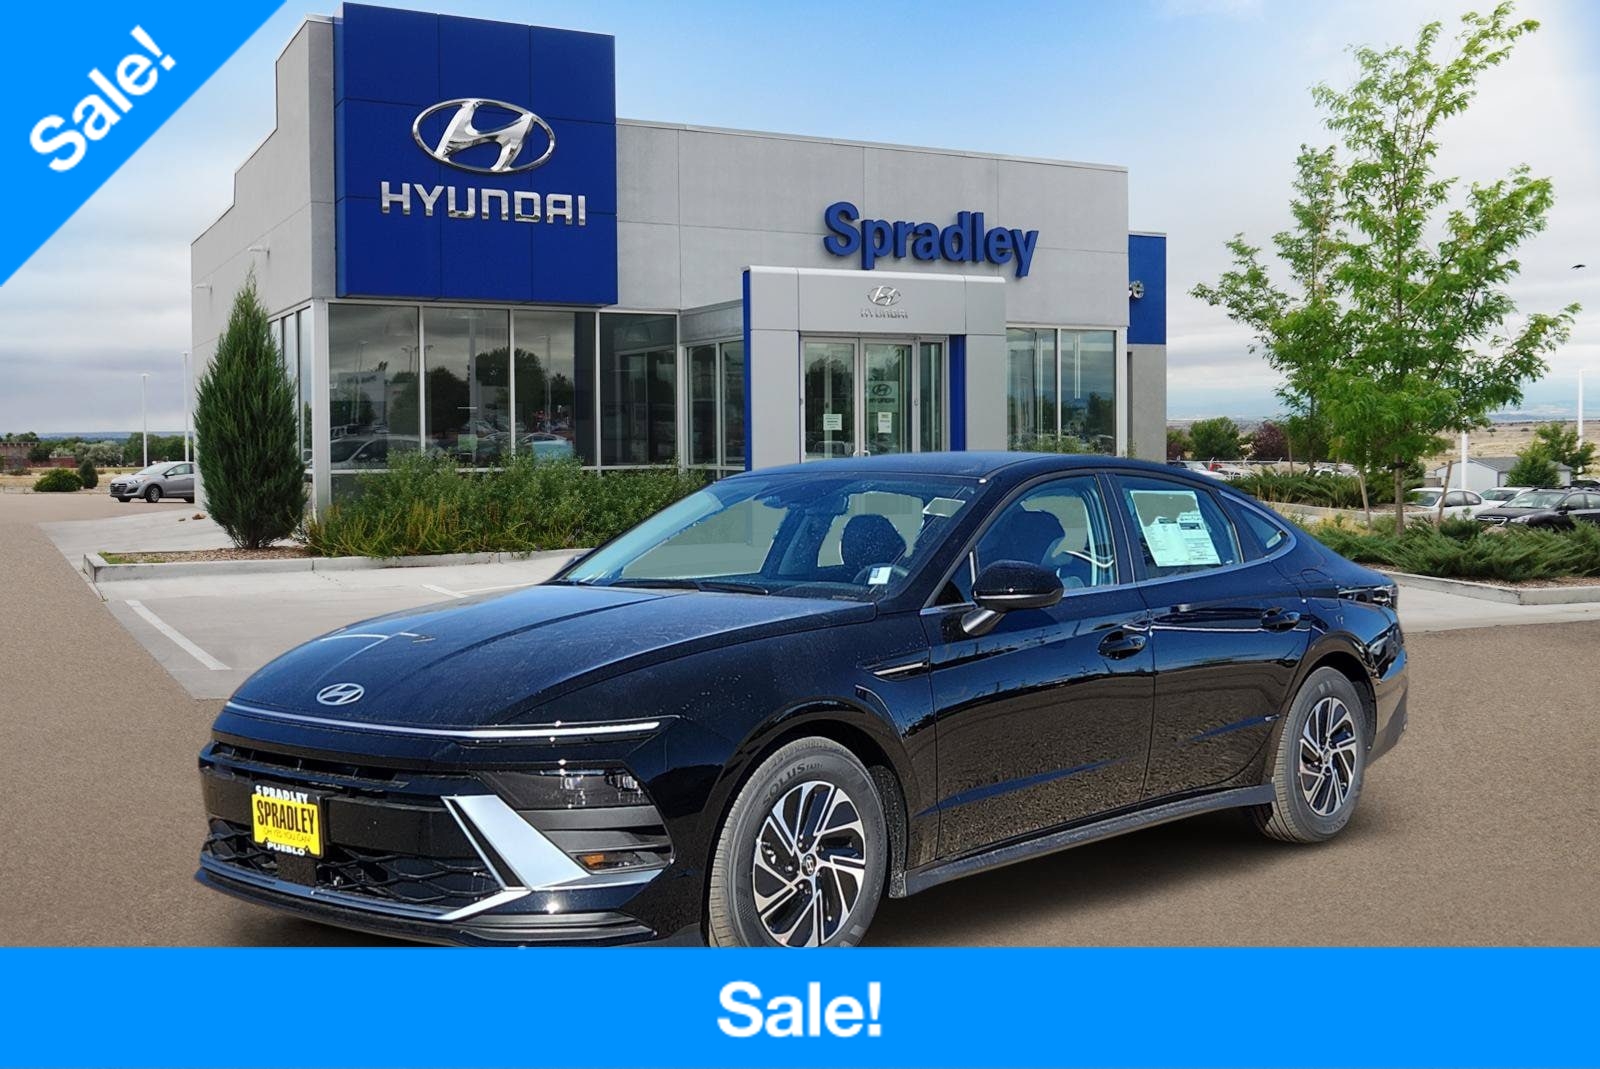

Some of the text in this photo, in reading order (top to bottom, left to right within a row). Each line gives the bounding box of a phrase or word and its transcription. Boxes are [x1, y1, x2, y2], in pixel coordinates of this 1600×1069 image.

[381, 181, 587, 226] HYUNDAI
[823, 201, 1039, 278] Spradley
[255, 784, 308, 805] SPRADLEY
[763, 762, 806, 808] SOLUS
[256, 799, 315, 835] SPRADLEY
[267, 841, 306, 857] PUEBLO
